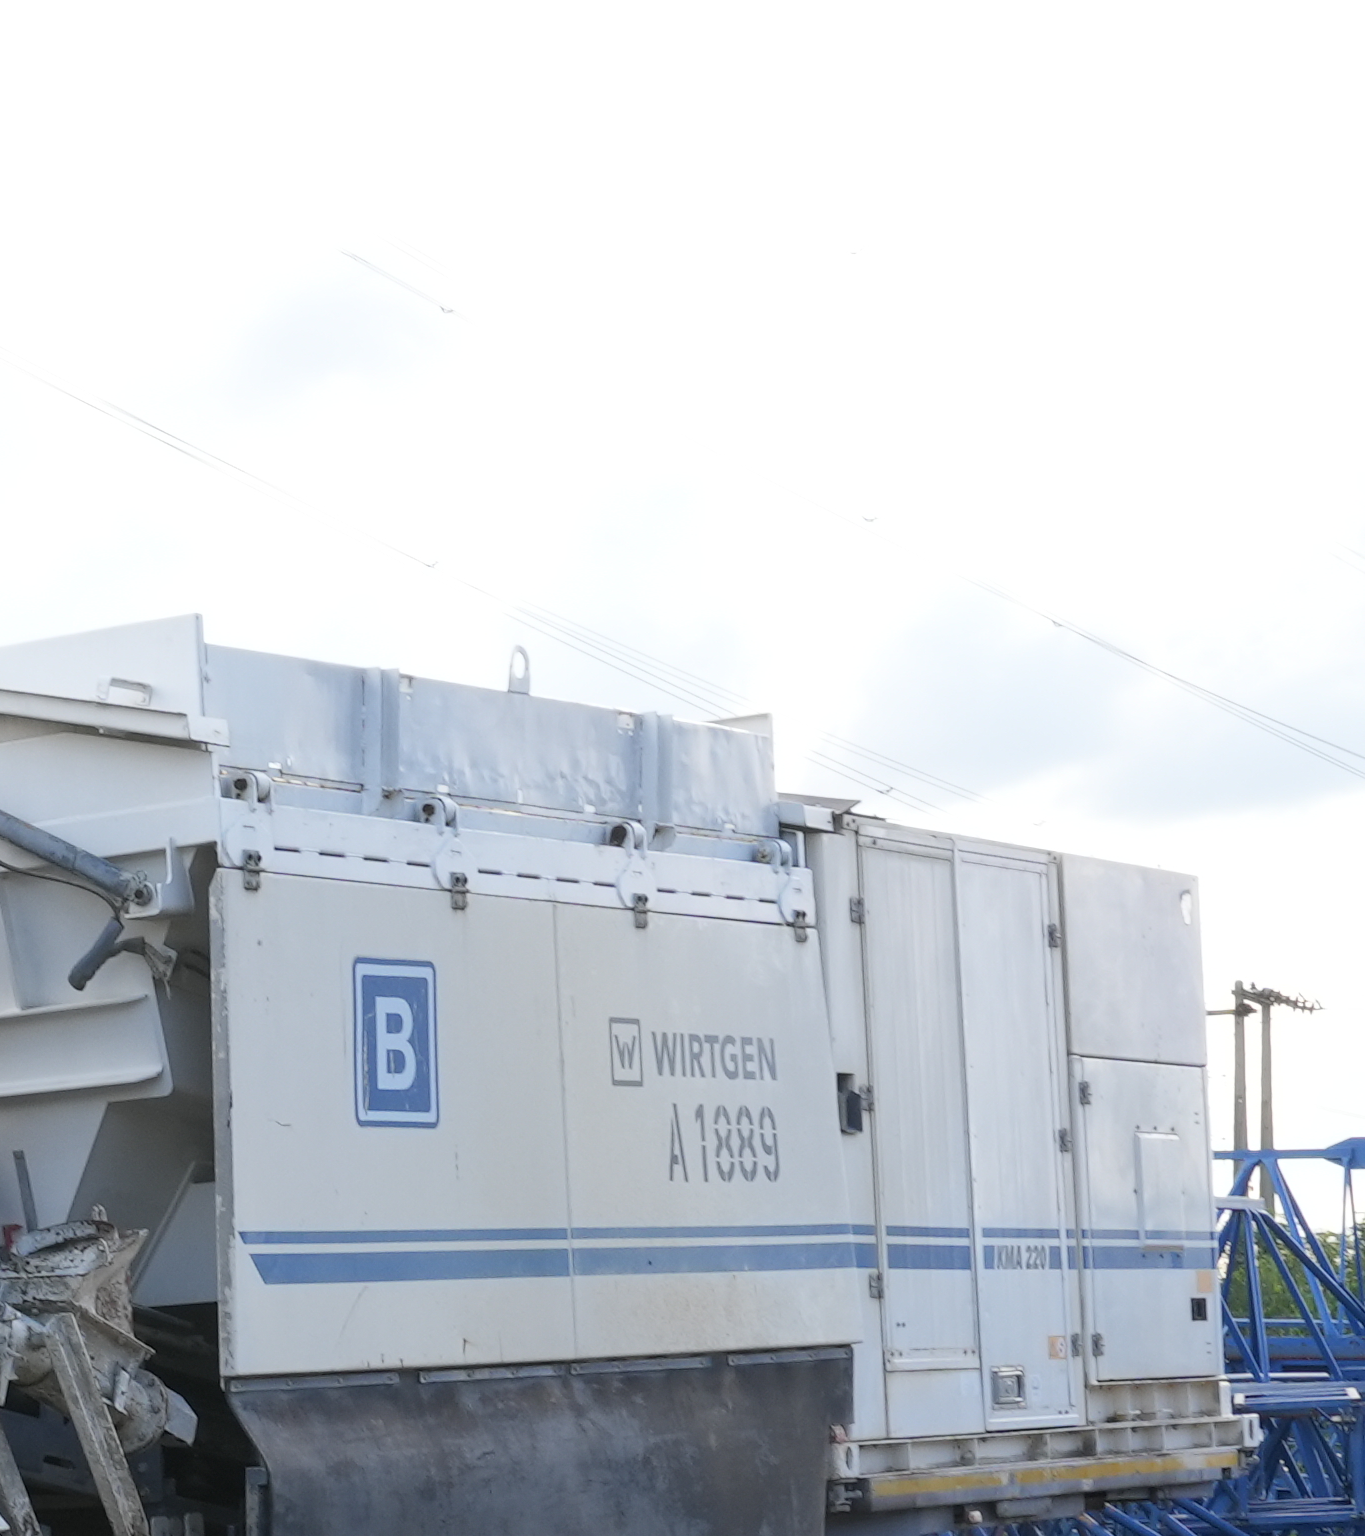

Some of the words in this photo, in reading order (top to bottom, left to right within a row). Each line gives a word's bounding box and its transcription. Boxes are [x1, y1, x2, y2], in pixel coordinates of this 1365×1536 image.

[374, 995, 418, 1092] B
[650, 1031, 778, 1081] WIRTGEN
[669, 1102, 781, 1183] A1889
[1025, 1244, 1048, 1270] 220
